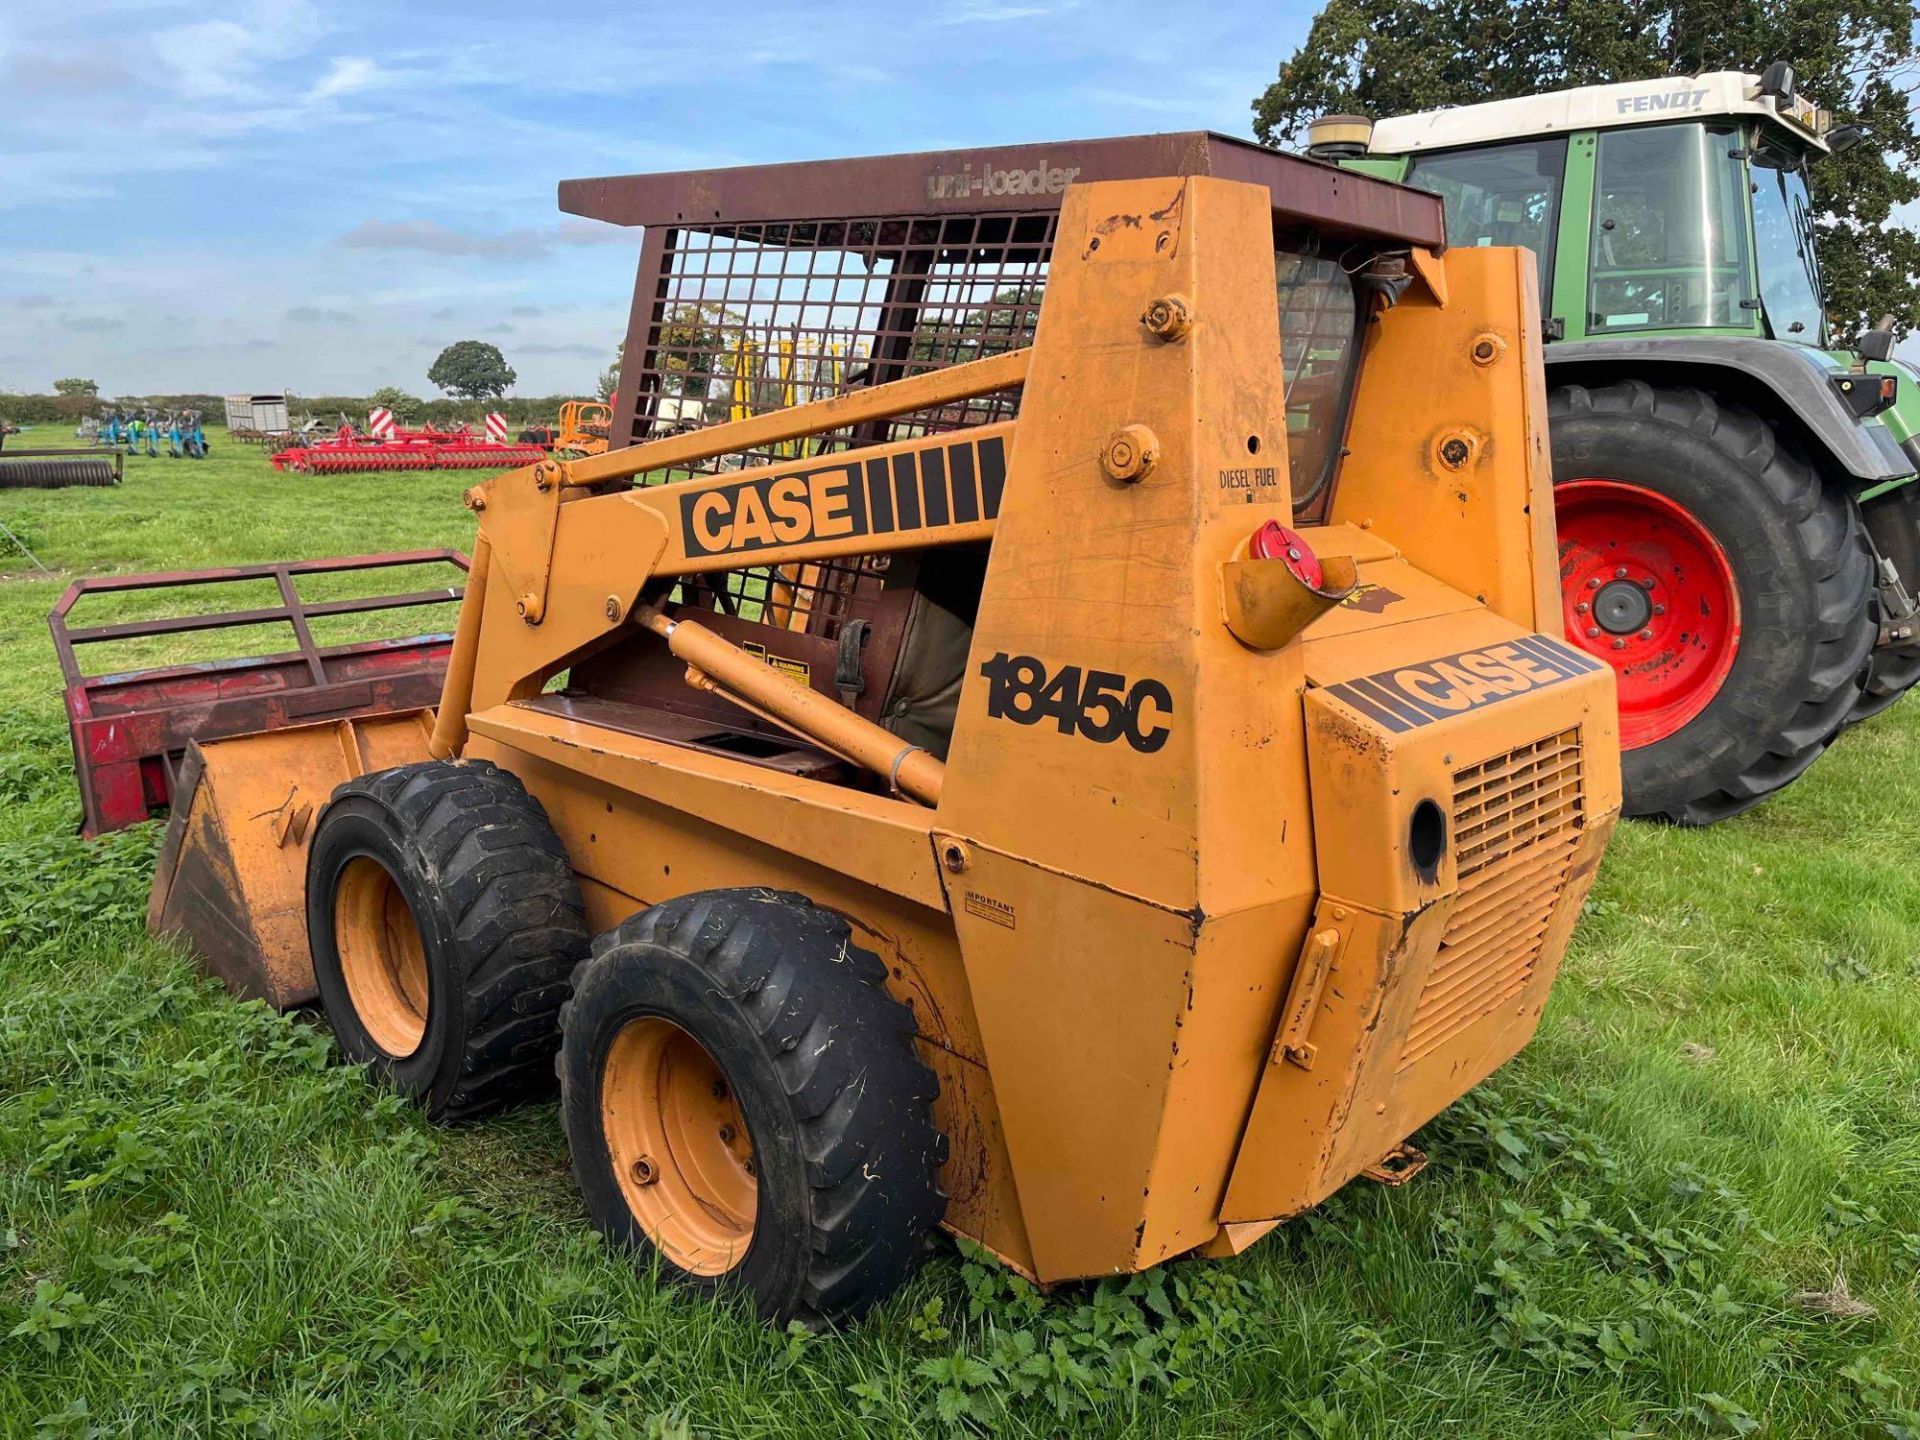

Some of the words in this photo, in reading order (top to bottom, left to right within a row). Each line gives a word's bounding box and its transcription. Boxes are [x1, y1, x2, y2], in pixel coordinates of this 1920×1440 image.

[1616, 88, 1711, 114] FENDT
[926, 159, 1081, 200] uni-loader
[1219, 470, 1250, 489] DIESEL
[1255, 467, 1277, 487] FUEL
[692, 469, 853, 552] CASE
[1394, 645, 1563, 710] CASE
[980, 652, 1173, 754] 1845C
[965, 890, 1014, 913] IMPORTANT
